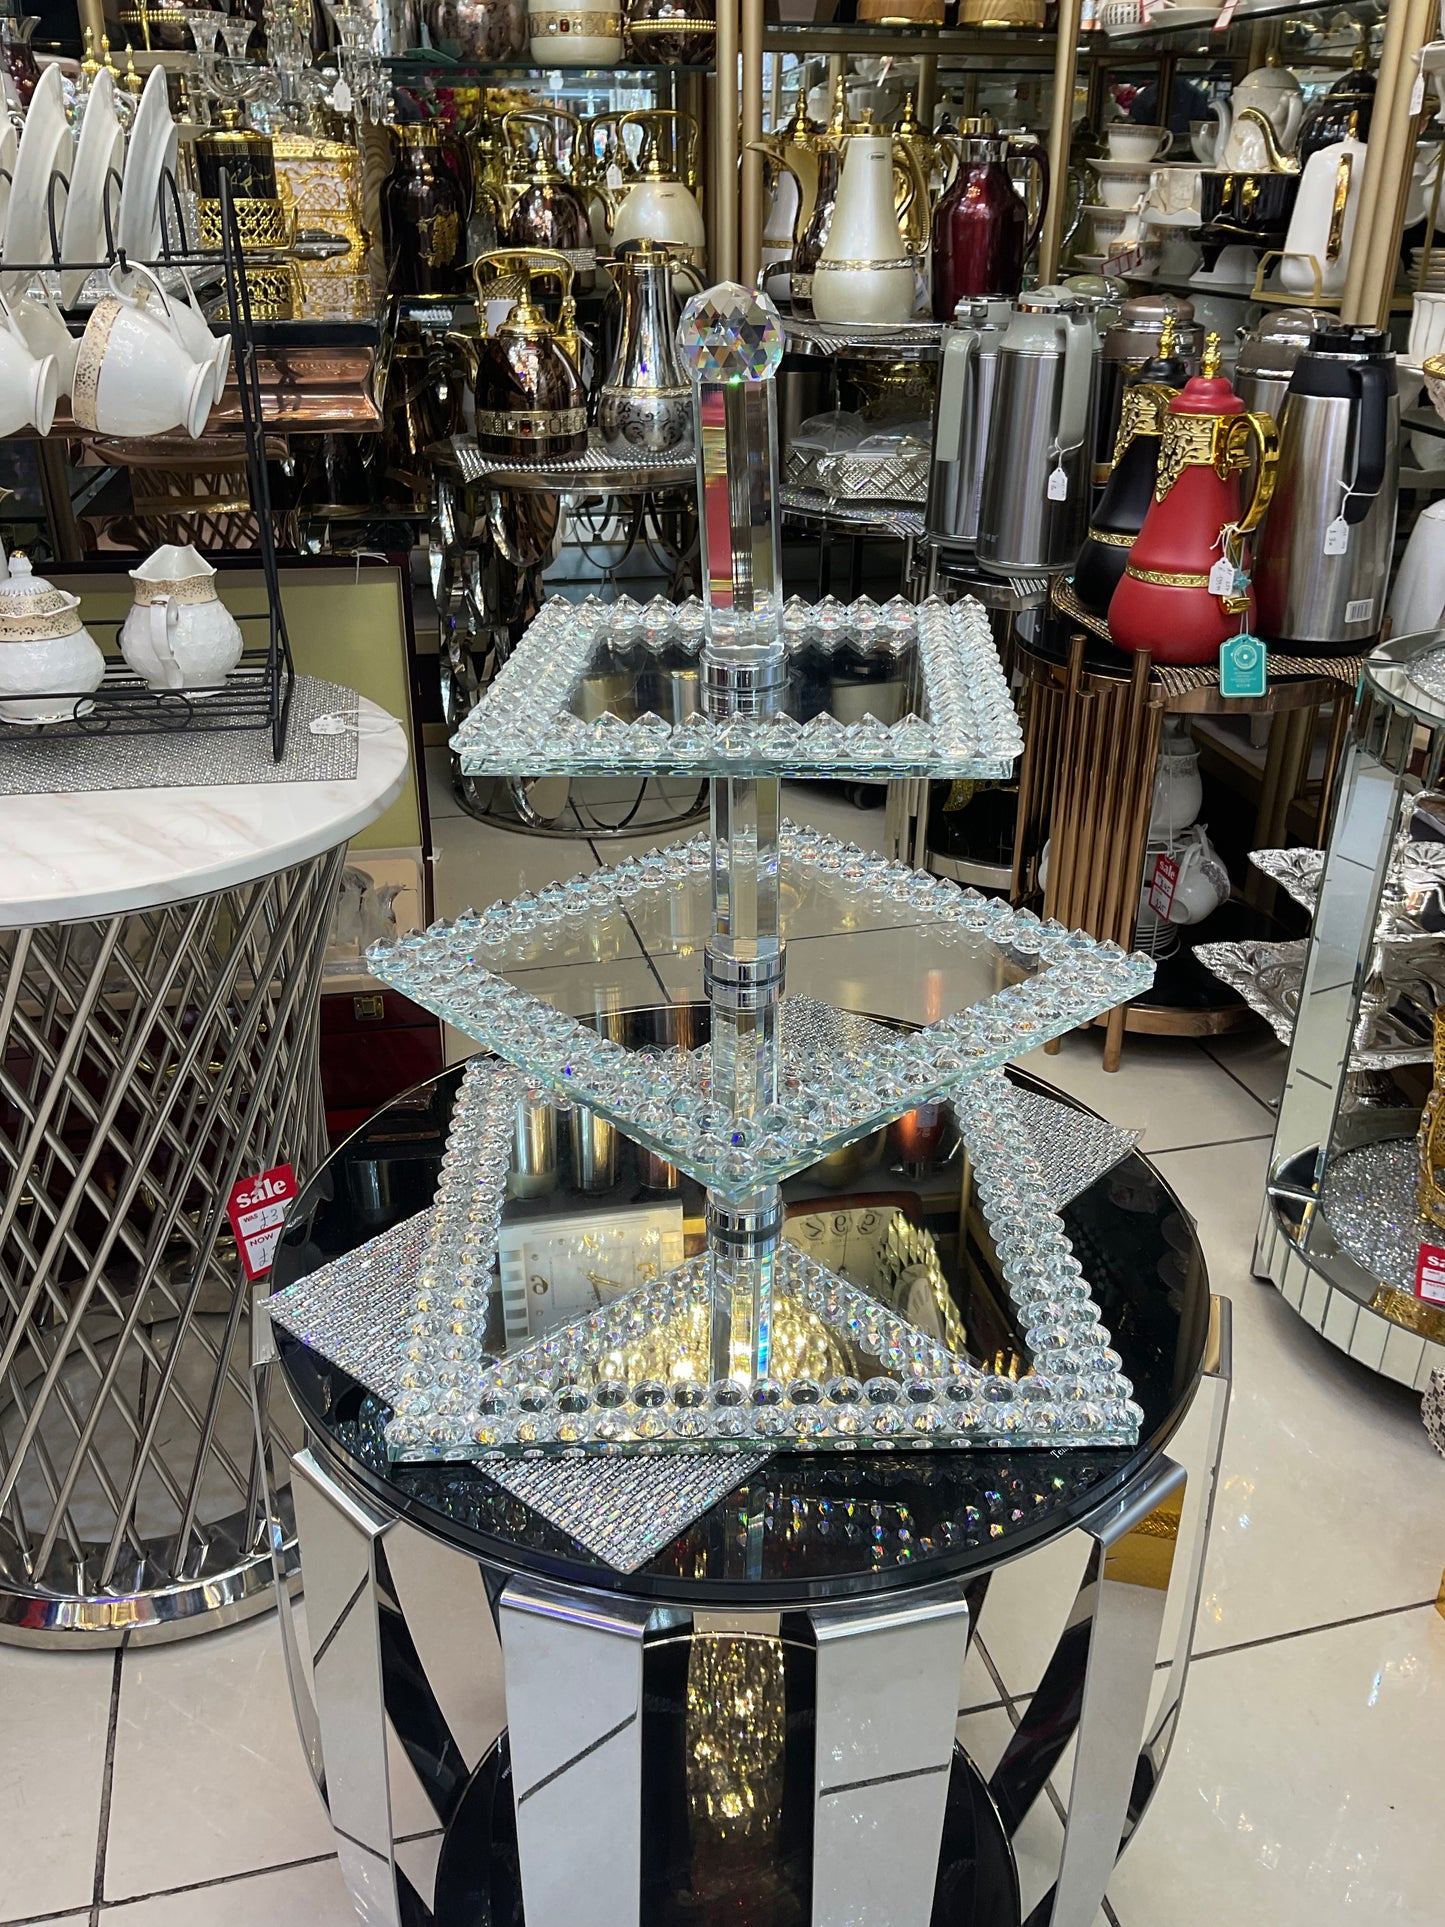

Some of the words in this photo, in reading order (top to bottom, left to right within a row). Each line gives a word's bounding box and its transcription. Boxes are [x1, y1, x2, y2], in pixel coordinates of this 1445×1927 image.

[1160, 861, 1175, 880] sale
[236, 1178, 287, 1209] sale
[243, 1213, 258, 1223] WAS
[249, 1232, 274, 1247] NOW
